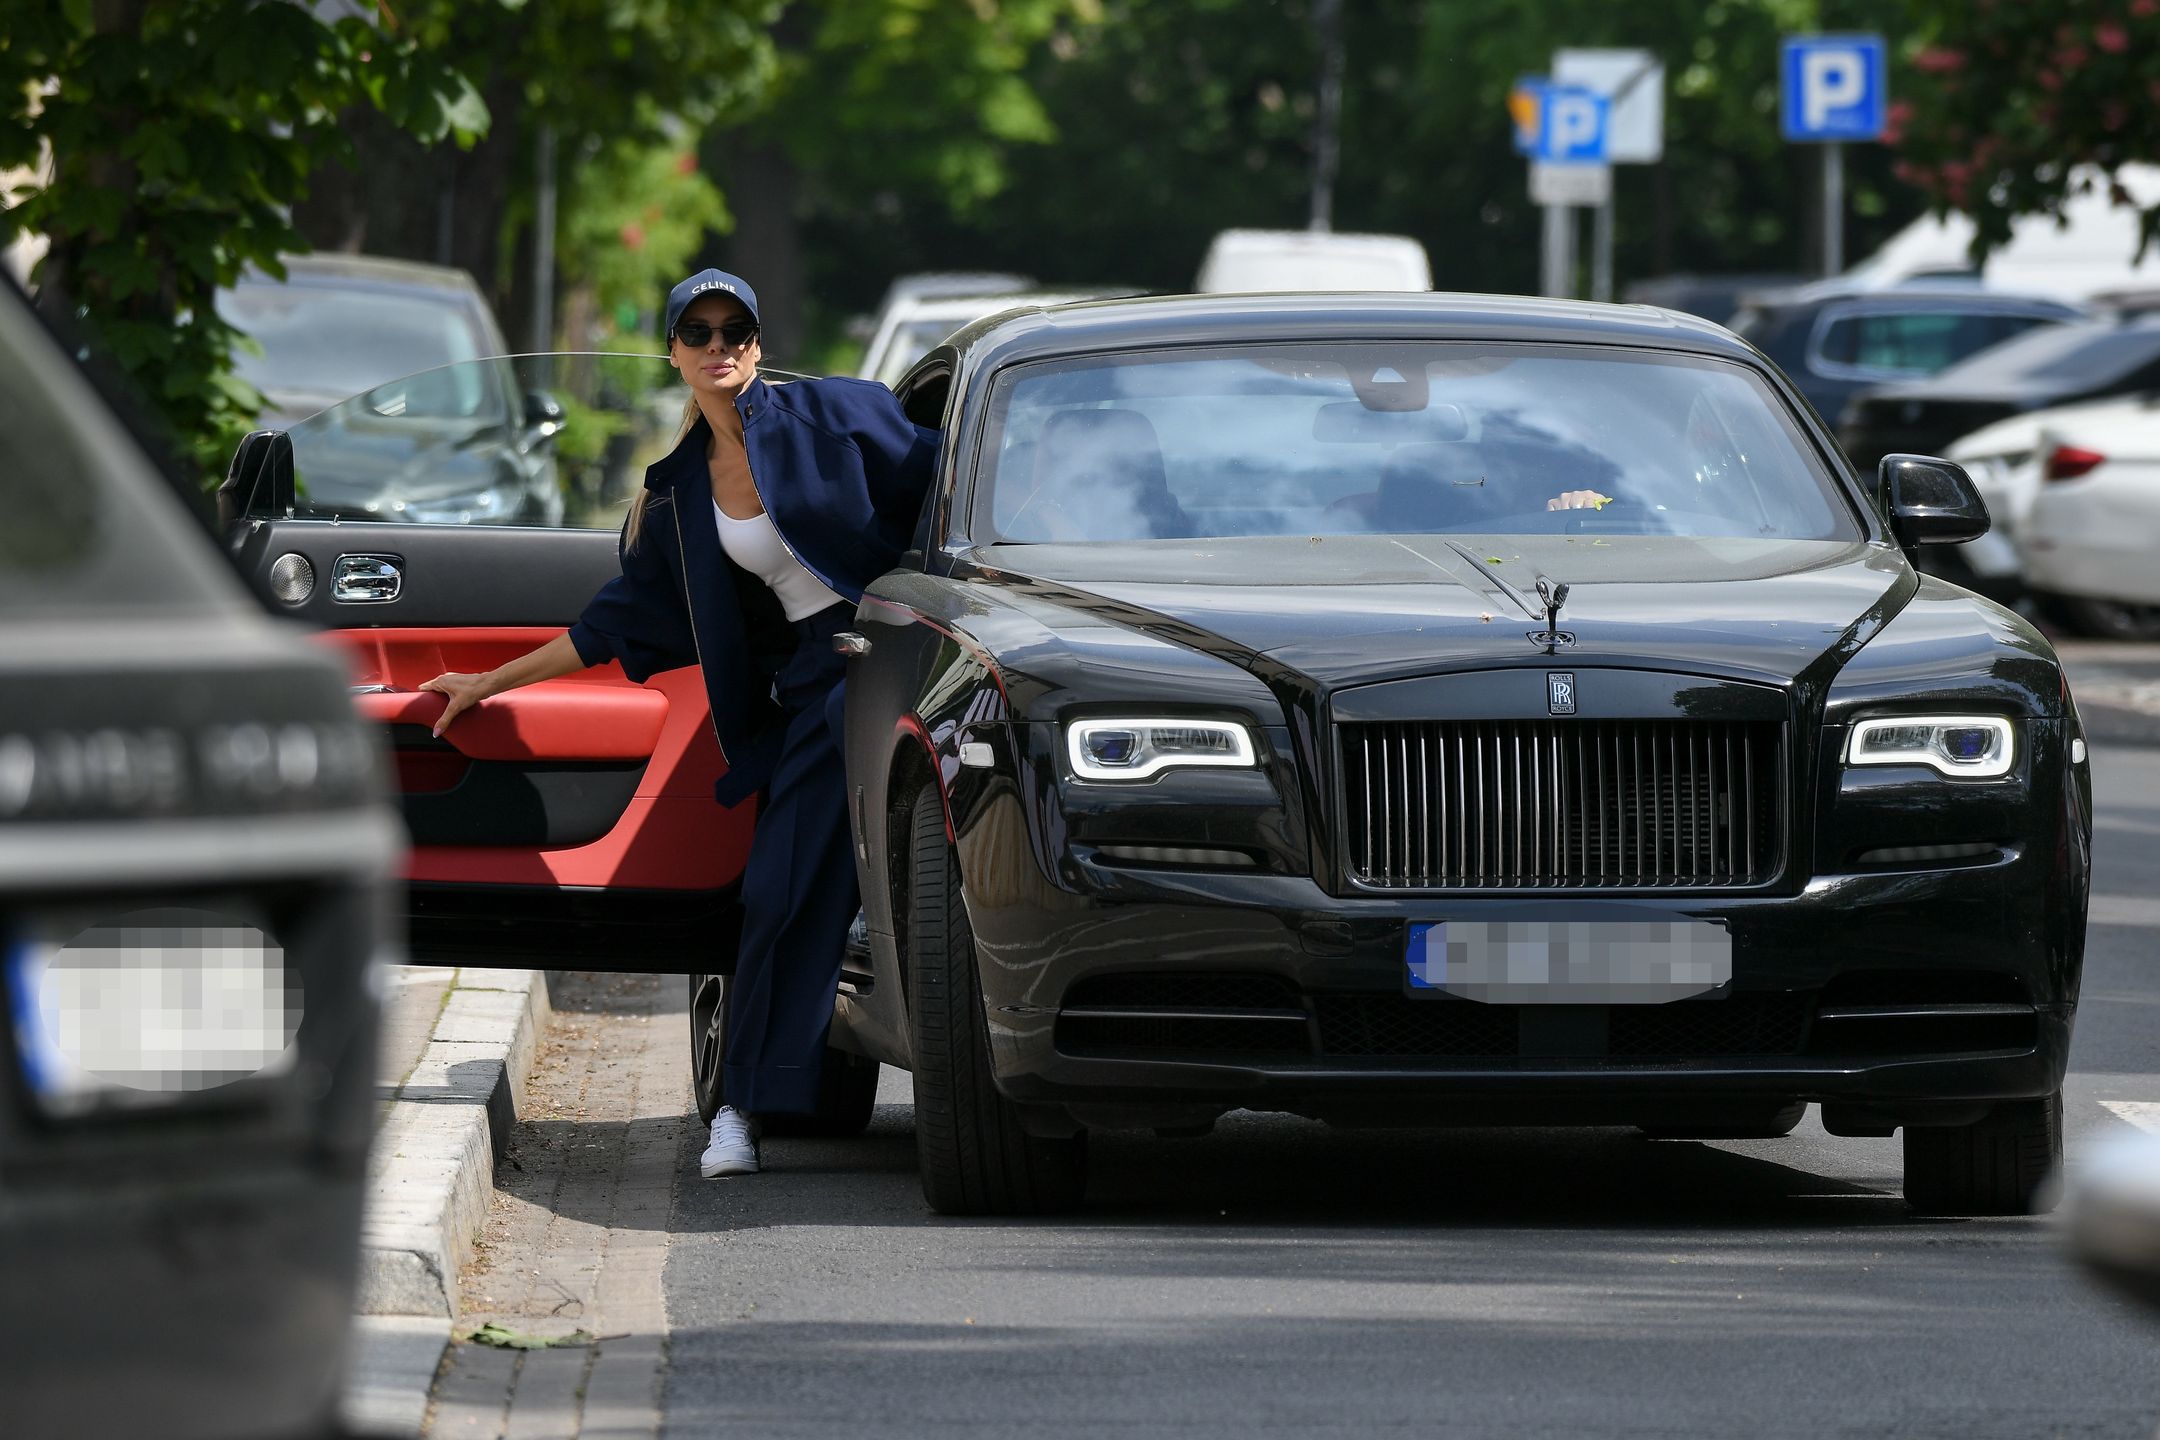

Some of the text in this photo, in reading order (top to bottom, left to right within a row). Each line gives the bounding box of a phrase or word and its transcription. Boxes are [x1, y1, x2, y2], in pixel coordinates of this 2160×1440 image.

[1804, 50, 1865, 130] P
[1551, 97, 1598, 158] P
[692, 281, 736, 294] CELINE
[1553, 682, 1571, 704] RR
